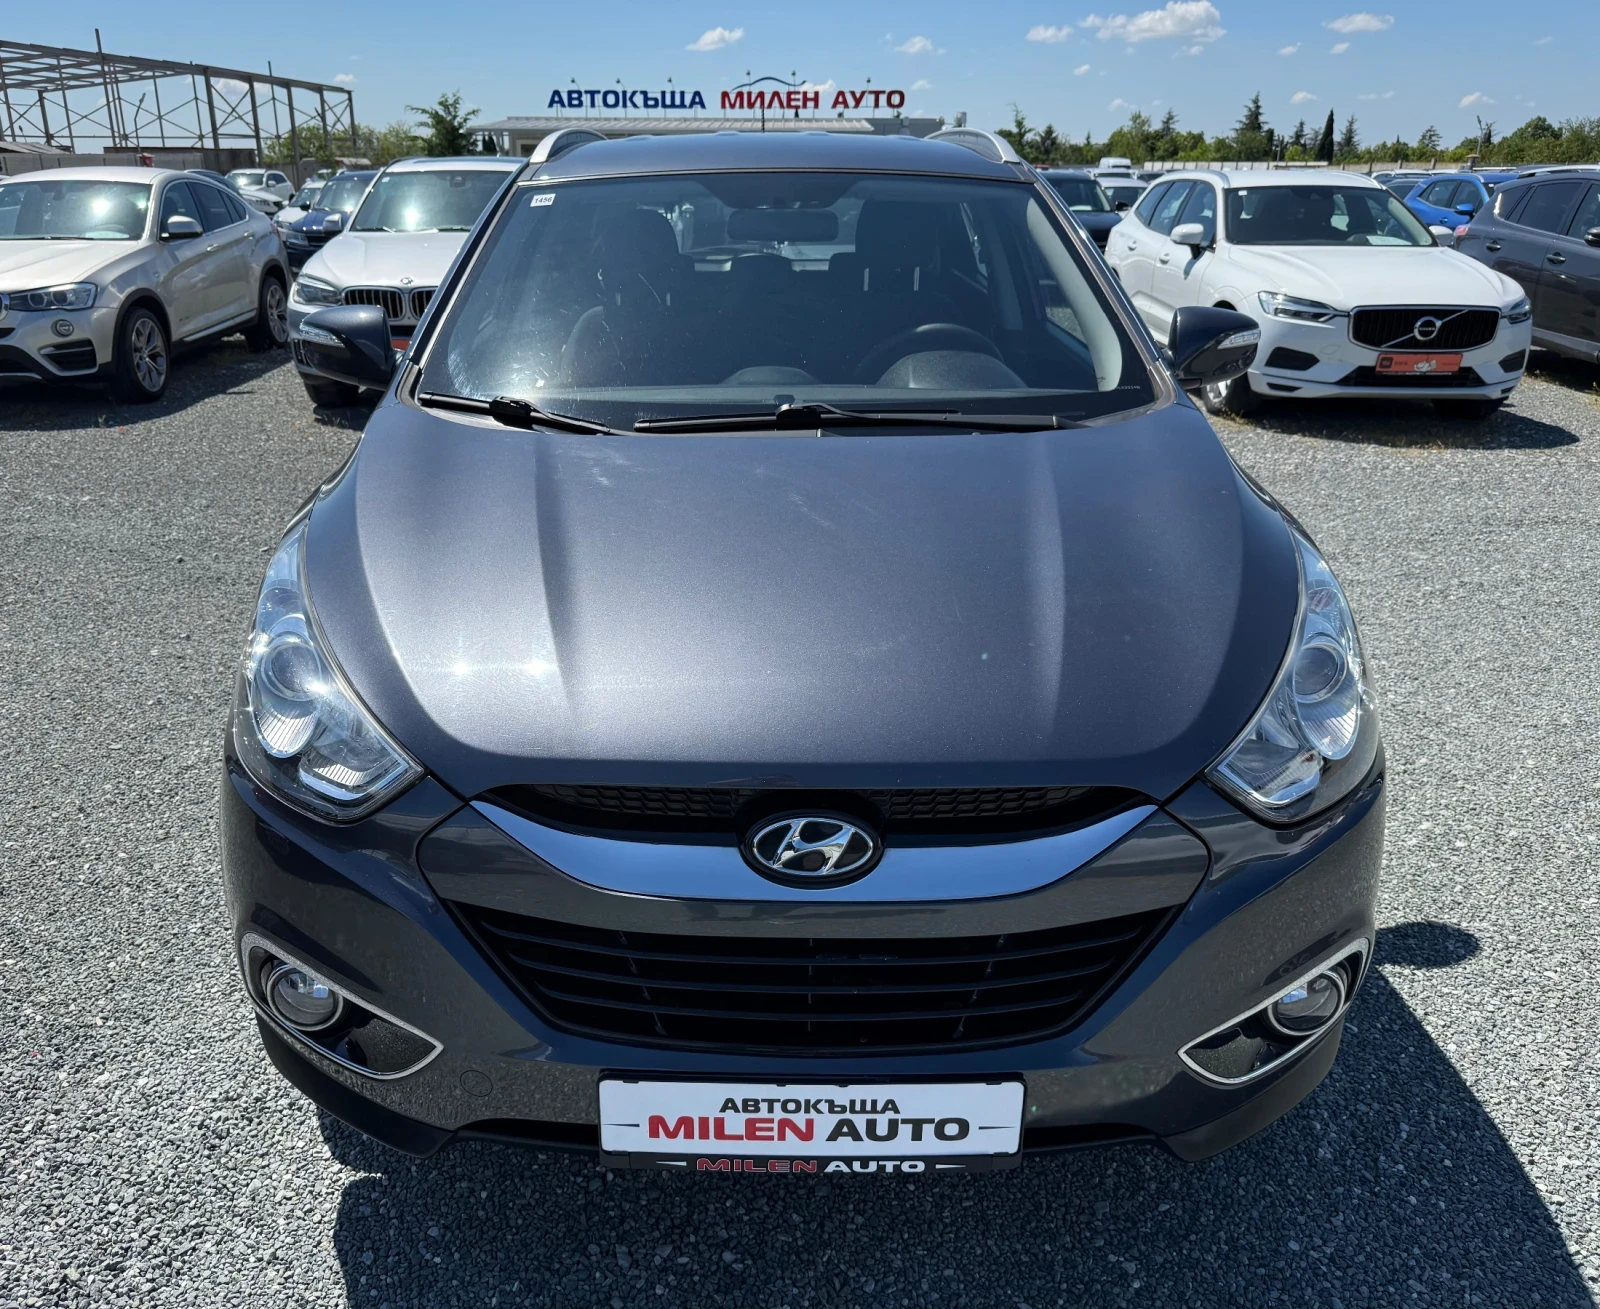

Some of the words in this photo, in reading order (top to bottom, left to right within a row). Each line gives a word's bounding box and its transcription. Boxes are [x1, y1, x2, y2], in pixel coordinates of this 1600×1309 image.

[720, 90, 820, 110] МИЛЕН
[830, 90, 906, 109] АУТО
[648, 1115, 815, 1142] MILEN
[825, 1117, 971, 1142] AUTO
[696, 1157, 818, 1173] MILEN
[823, 1160, 926, 1173] AUTO
